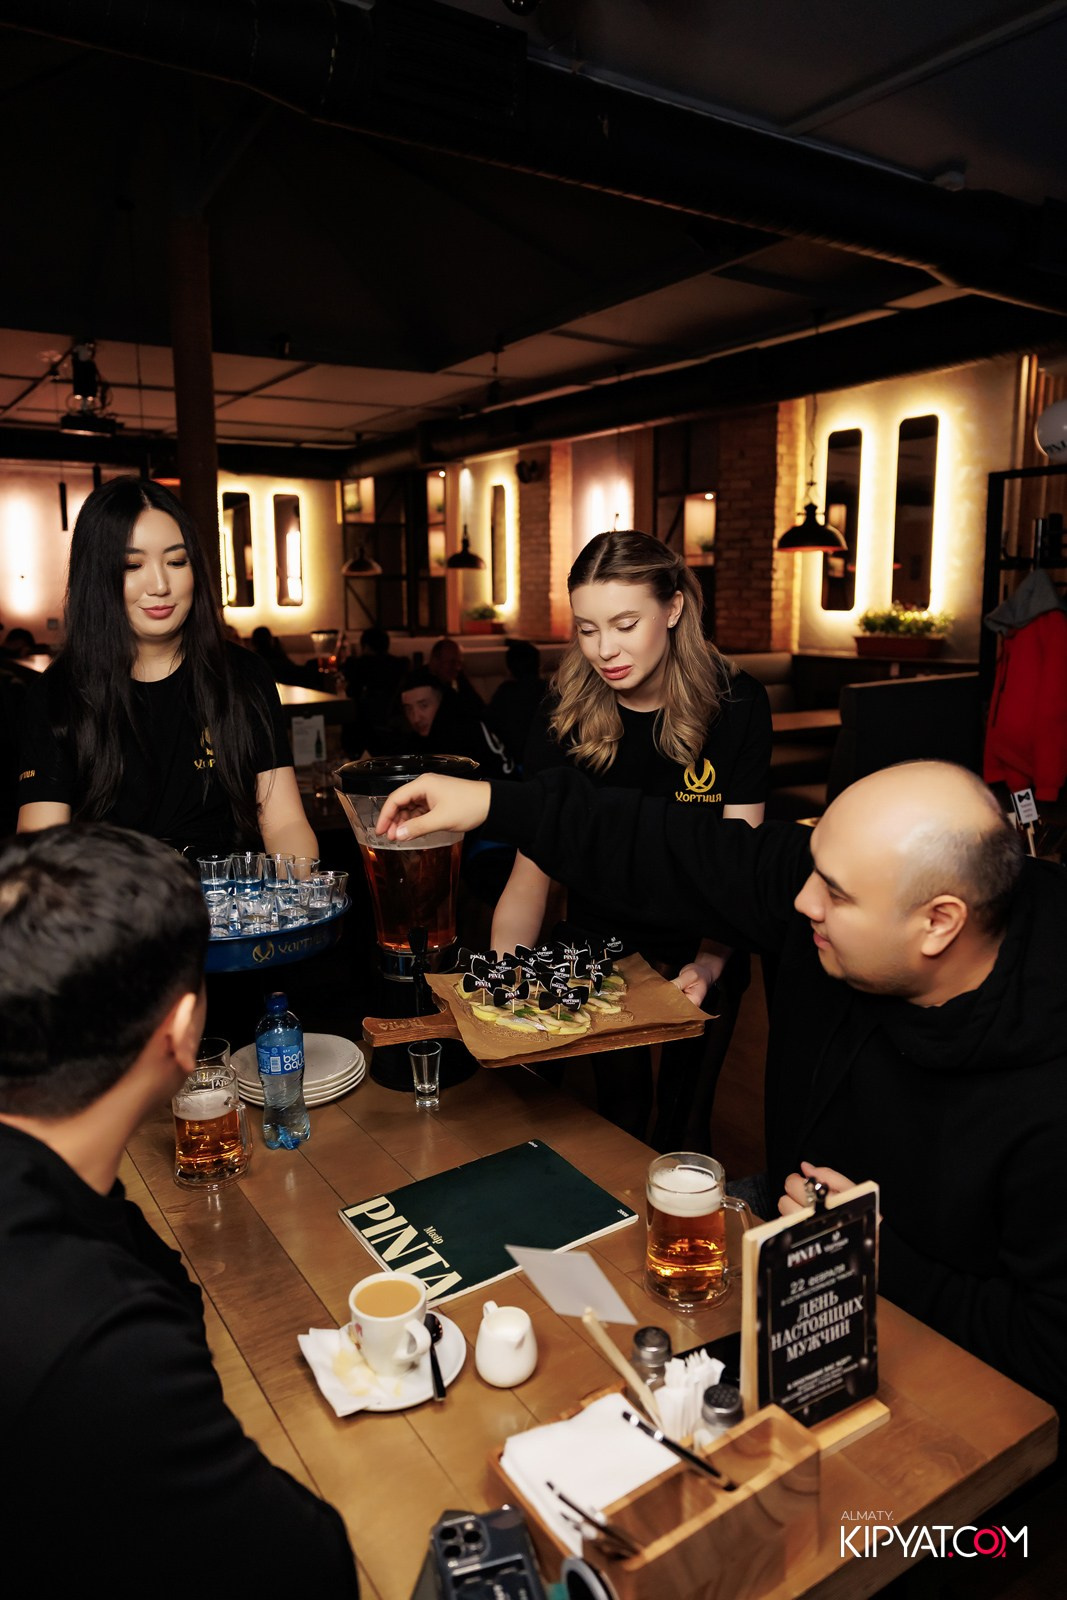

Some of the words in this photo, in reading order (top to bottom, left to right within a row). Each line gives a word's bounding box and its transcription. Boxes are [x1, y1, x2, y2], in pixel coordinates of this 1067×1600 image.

[675, 791, 722, 803] ХОРТИЦЯ
[474, 980, 492, 988] PINTA
[343, 1195, 463, 1302] PINTA
[790, 1278, 806, 1296] 22
[797, 1290, 840, 1322] ДЕНЬ
[771, 1294, 864, 1352] НАСТОЯЩИХ
[786, 1319, 851, 1362] МУЖЧИН
